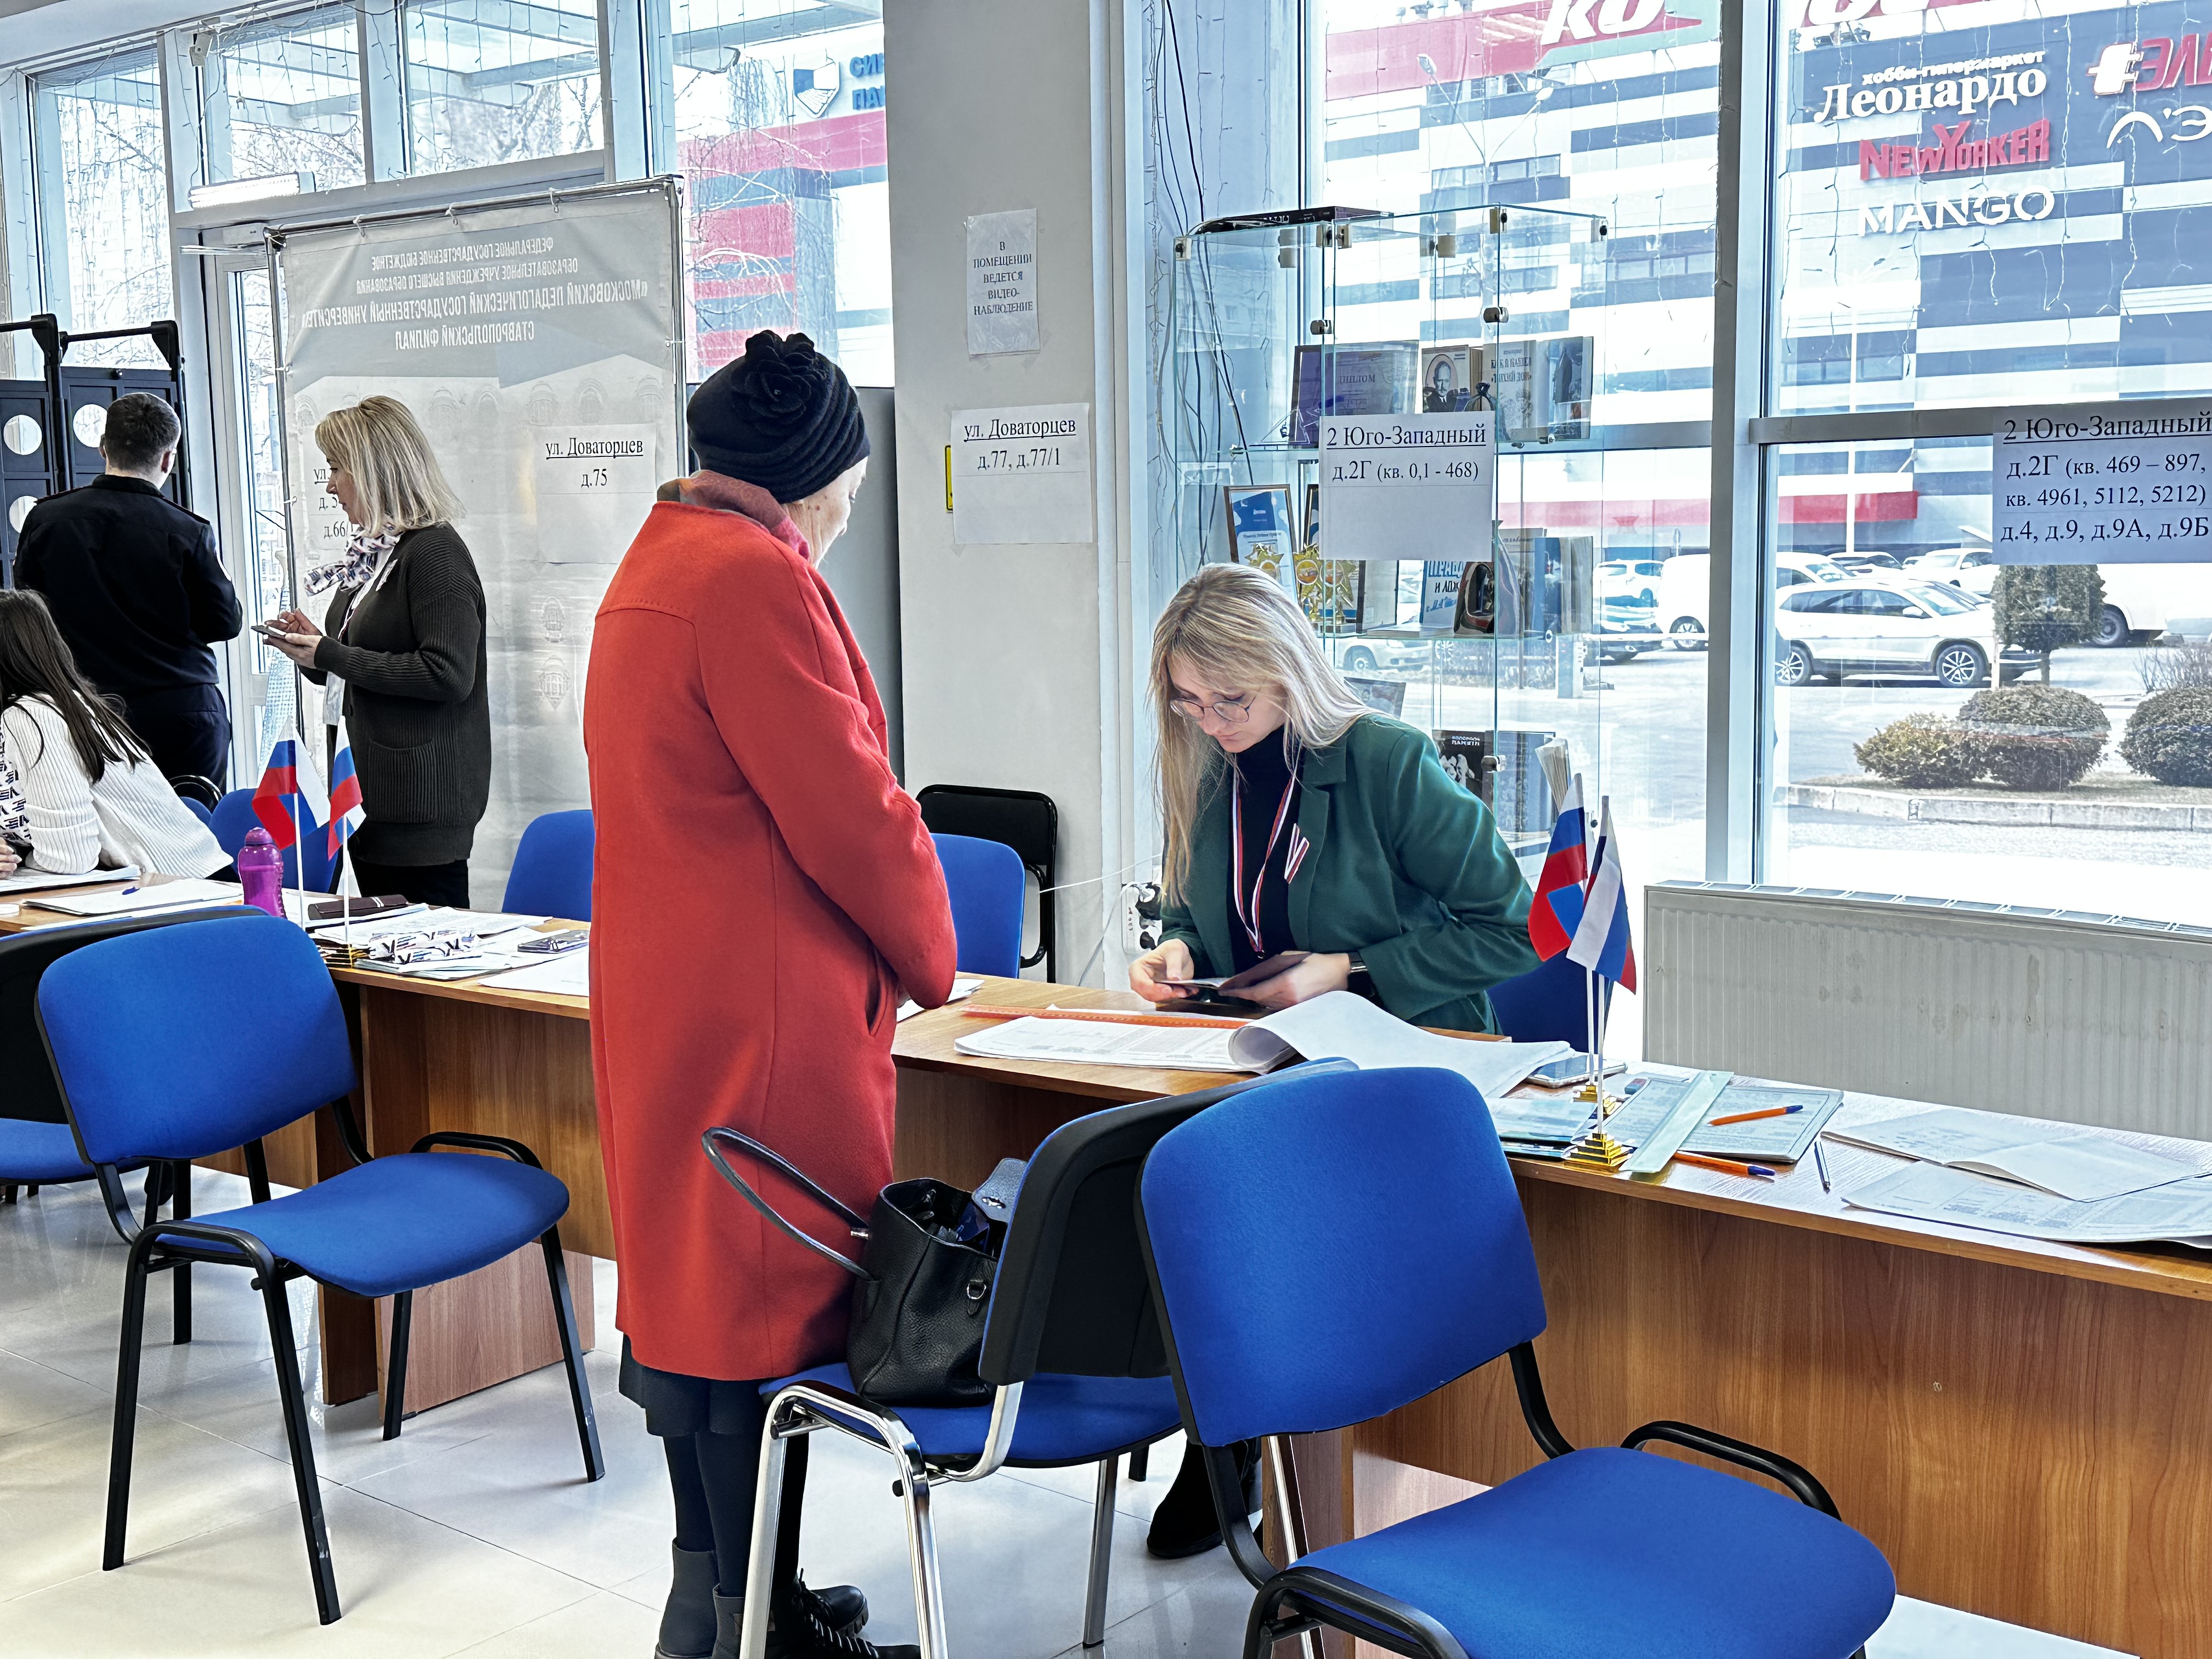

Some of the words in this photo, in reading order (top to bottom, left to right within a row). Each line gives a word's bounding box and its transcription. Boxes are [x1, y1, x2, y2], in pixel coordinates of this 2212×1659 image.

[1813, 68, 2047, 123] Леонардо
[1858, 184, 2055, 237] MANGO
[1000, 241, 1006, 251] В
[973, 253, 1032, 268] ПОМЕЩЕНИИ
[983, 271, 1023, 284] ВЕДЕТСЯ
[974, 301, 1033, 315] НАБЛЮДЕНИЕ
[963, 425, 984, 442] ул.
[989, 419, 1076, 439] Доваторцев
[1327, 427, 1337, 446] 2
[1344, 423, 1486, 445] Юго-Западный
[2003, 420, 2017, 441] 2
[2025, 411, 2212, 439] Юго-Западный
[545, 443, 563, 459] ул.
[567, 437, 644, 459] Доваторцев
[978, 450, 1012, 471] д.77,
[1017, 447, 1060, 469] д.77/1
[580, 468, 607, 488] д.75
[1332, 460, 1372, 482] д.2Г
[1377, 463, 1404, 483] (кв.
[1409, 462, 1429, 481] 0,1
[1445, 461, 1479, 481] 468)
[2006, 454, 2058, 480] д.2Г
[2065, 458, 2100, 479] (кв.
[2106, 455, 2140, 473] 469
[2165, 453, 2205, 474] 897,
[2006, 494, 2031, 507] кв.
[2037, 488, 2087, 508] 4961,
[2094, 485, 2144, 507] 5112,
[2151, 484, 2207, 506] 5212)
[2000, 521, 2039, 544] д.4,
[2045, 519, 2084, 543] д.9,
[2091, 518, 2151, 542] д.9А,
[2158, 516, 2209, 540] д.9Б
